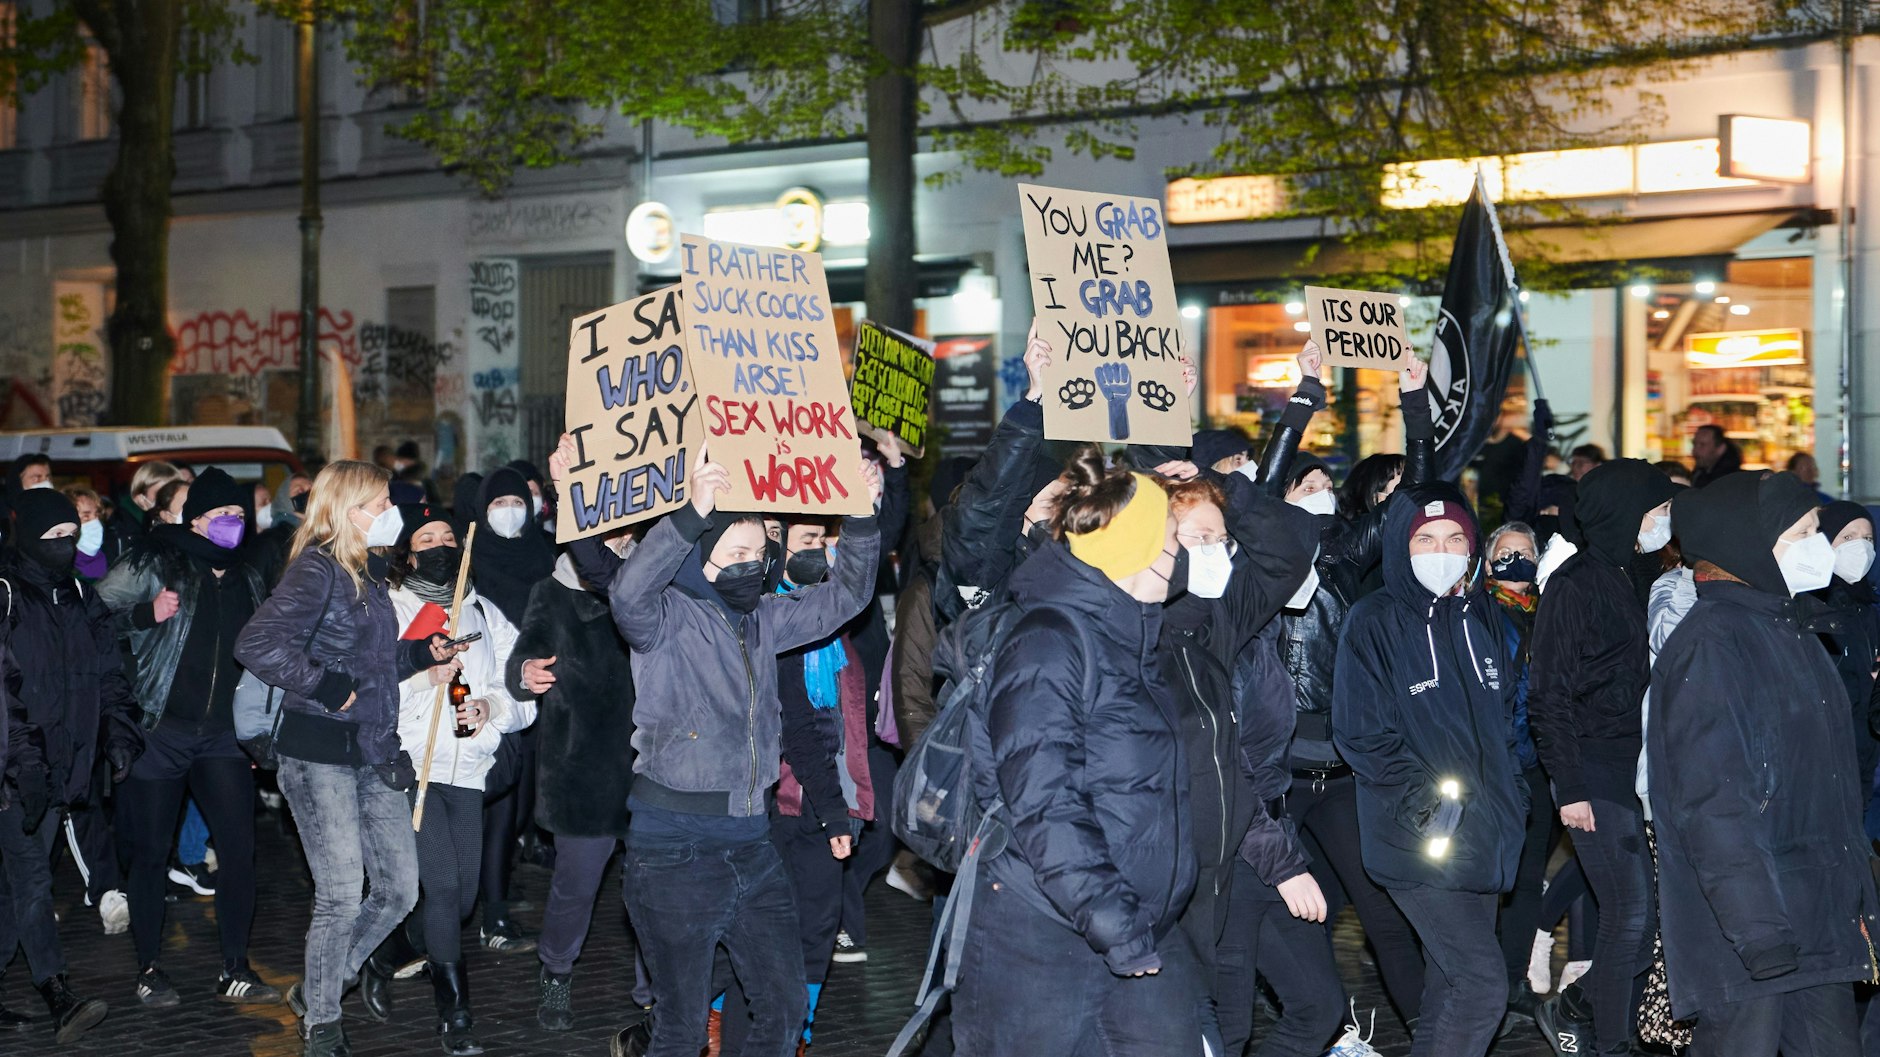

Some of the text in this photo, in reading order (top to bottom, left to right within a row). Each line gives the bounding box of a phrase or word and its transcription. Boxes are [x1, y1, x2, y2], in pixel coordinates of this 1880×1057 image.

[1027, 193, 1161, 240] YOU GRAB
[682, 243, 810, 284] I RATHER
[1073, 241, 1134, 279] ME?
[692, 280, 825, 322] SUCK COCKS
[1039, 277, 1153, 318] I GRAB
[1322, 298, 1399, 328] ITS OUR
[578, 313, 608, 364] I
[627, 289, 683, 346] SA
[693, 324, 819, 363] THAN KISS
[1057, 320, 1182, 362] YOU BACK!
[1325, 328, 1402, 361] PERIOD
[733, 362, 808, 397] ARSE!
[852, 380, 877, 408] KEIT
[874, 392, 902, 418] ABER
[568, 393, 698, 474] I SAY
[706, 394, 853, 440] SEX WORK
[866, 407, 896, 431] GEHT
[900, 420, 921, 448] HIN
[129, 433, 188, 444] WESTFALIA
[774, 436, 792, 456] is
[569, 447, 687, 533] WHEN!
[743, 453, 849, 505] WORK
[1409, 678, 1440, 696] ESPRIT
